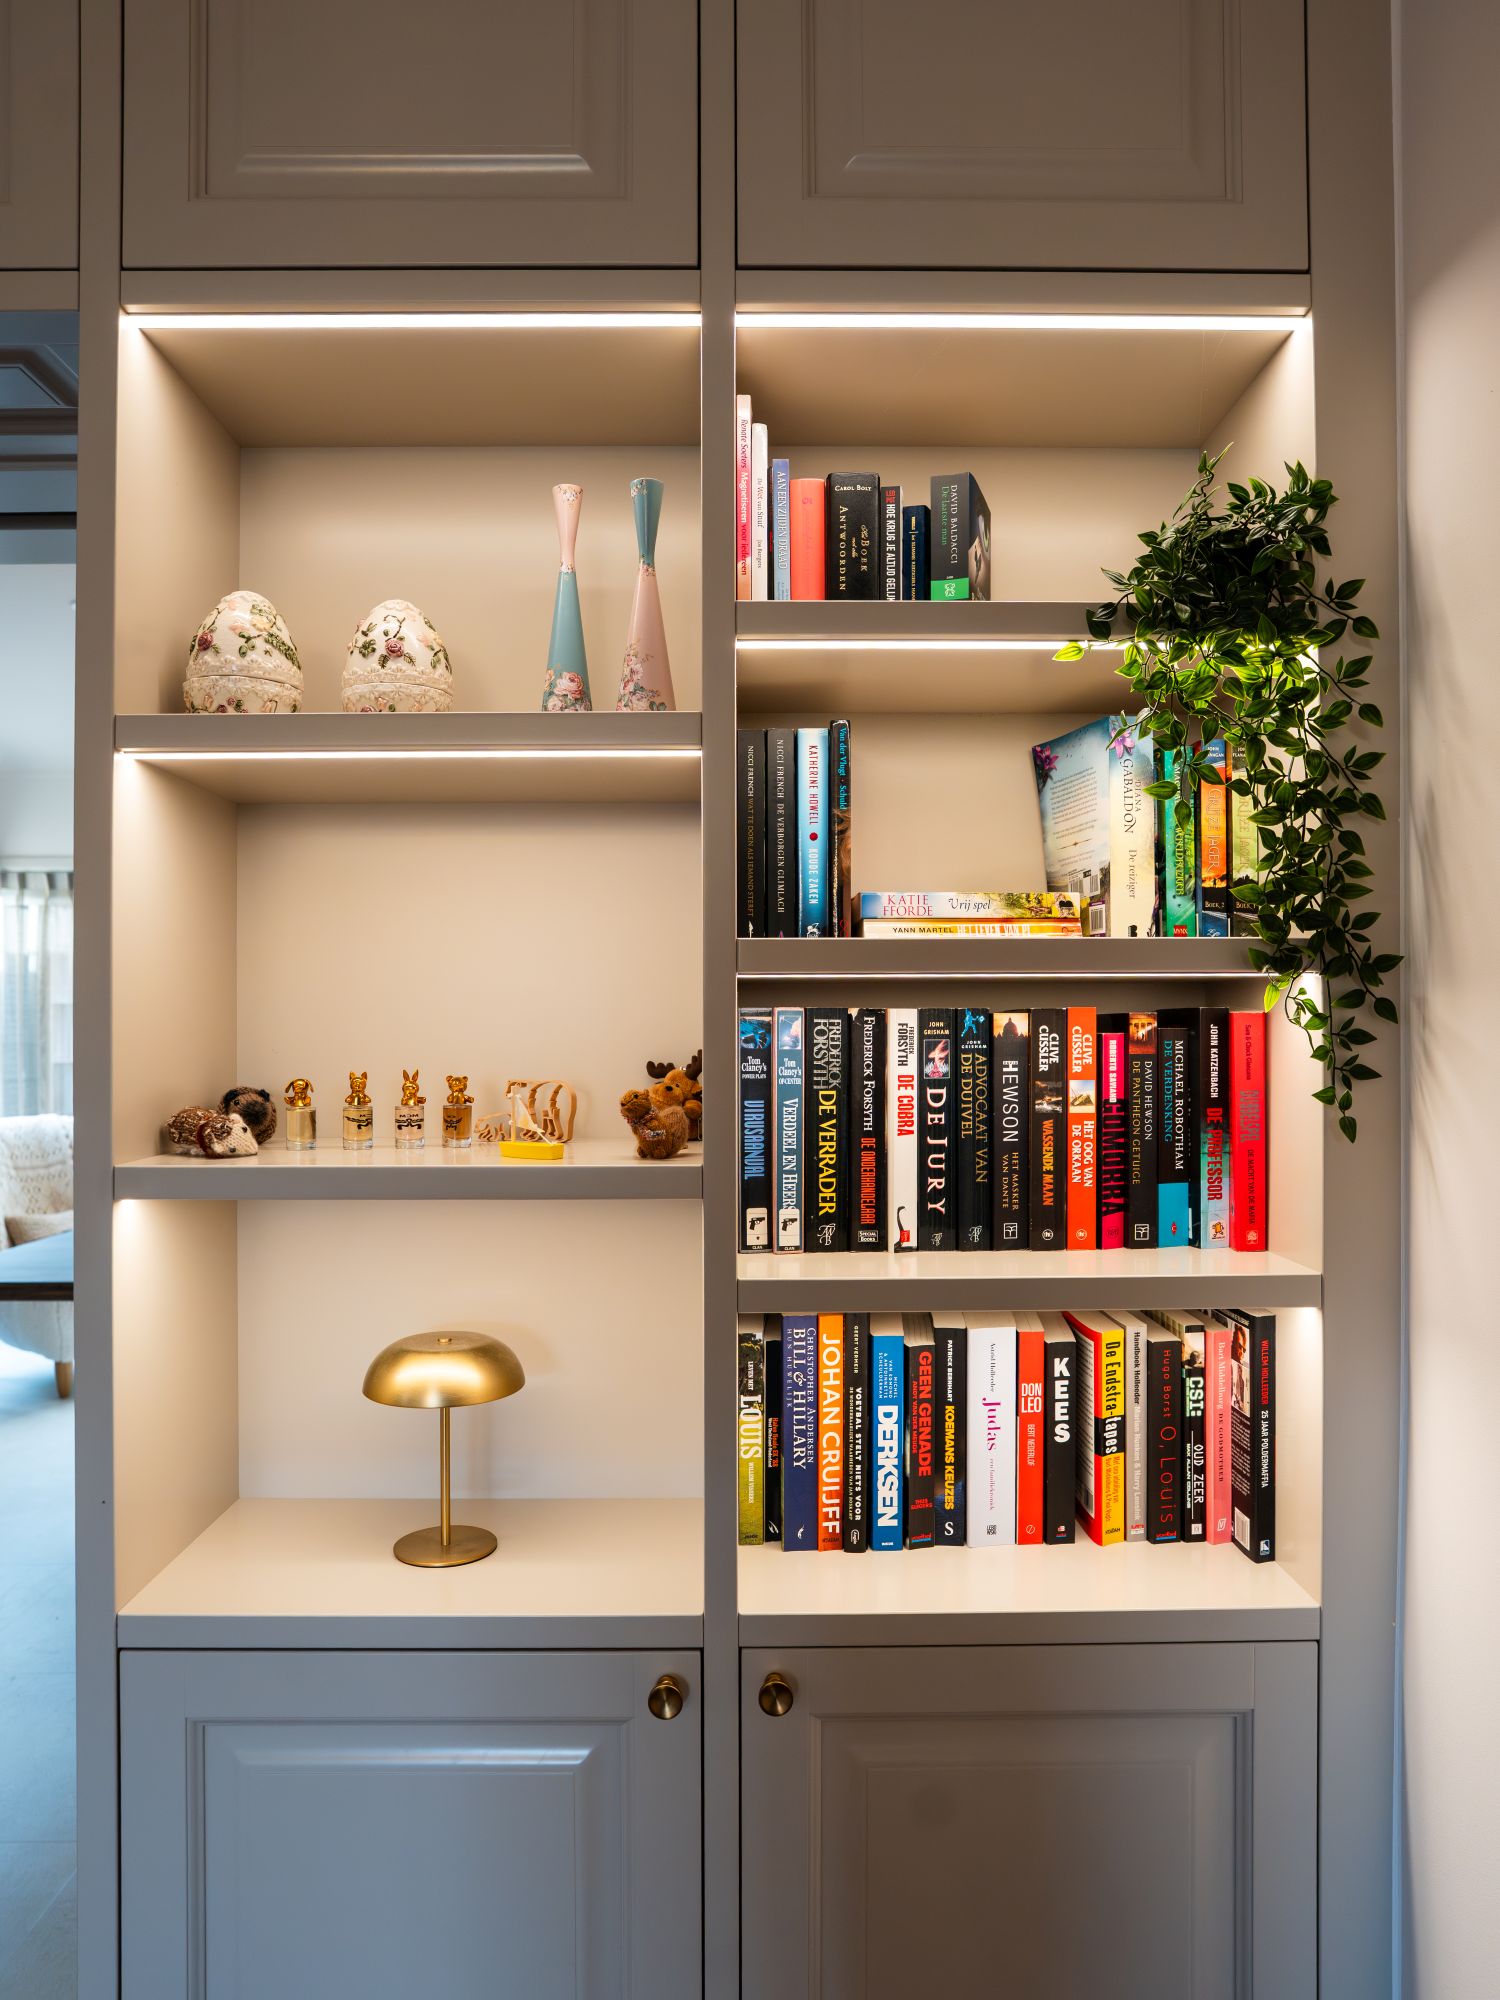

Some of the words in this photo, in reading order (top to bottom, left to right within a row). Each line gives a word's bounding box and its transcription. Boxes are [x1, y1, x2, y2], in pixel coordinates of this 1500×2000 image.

[740, 420, 748, 442] Renate
[739, 472, 748, 522] Magnetiseren
[778, 472, 786, 490] AAN
[942, 486, 949, 498] De
[778, 492, 786, 508] EEN
[942, 500, 950, 528] laatste
[776, 508, 786, 538] ZIJDEN
[740, 542, 748, 575] iedereen
[778, 539, 787, 569] DRAAD
[840, 506, 848, 590] ANTWOORDEN
[809, 745, 818, 789] KATHERINE
[838, 756, 847, 776] Vlugt
[777, 804, 784, 814] DE
[809, 794, 818, 825] HOWELL
[1120, 759, 1136, 833] GABALDON
[809, 848, 818, 874] KOUDE
[1128, 850, 1137, 862] De
[809, 878, 818, 904] ZAKEN
[1126, 863, 1137, 898] reiziger
[883, 906, 933, 916] FFORDE
[888, 895, 929, 905] KATIE
[747, 1056, 760, 1064] Tom
[813, 1018, 828, 1089] FORSYTH
[829, 1019, 841, 1088] FREDERICK
[864, 1017, 876, 1076] FREDERICK
[898, 1023, 908, 1066] FORSYTH
[1039, 1025, 1049, 1072] CUSSLER
[1050, 1033, 1059, 1064] CLIVE
[1072, 1026, 1082, 1073] CUSSLER
[1083, 1034, 1092, 1065] CLIVE
[1109, 1040, 1117, 1071] ROBERTO
[1164, 1041, 1172, 1057] DE
[741, 1062, 767, 1073] Clancy's
[779, 1067, 801, 1077] Clancy's
[784, 1058, 796, 1067] Tom
[961, 1053, 972, 1073] DE
[1132, 1062, 1140, 1073] DE
[1175, 1040, 1183, 1095] MICHAEL
[898, 1075, 914, 1090] DE
[975, 1053, 987, 1142] ADVOCAAT
[1109, 1073, 1117, 1102] SAVIANO
[819, 1090, 836, 1115] DE
[864, 1080, 875, 1131] FORSYTH
[897, 1095, 914, 1136] COBRA
[927, 1087, 946, 1125] DE
[961, 1079, 972, 1138] DUIVEL
[1003, 1061, 1019, 1141] HEWSON
[1132, 1078, 1140, 1134] PANTHEON
[1164, 1059, 1172, 1142] VERDENKING
[1207, 1108, 1222, 1124] DE
[744, 1100, 764, 1180] VIRUSAANVAL
[783, 1098, 798, 1152] VERDEEL
[1072, 1125, 1081, 1137] DE
[1084, 1120, 1094, 1139] HET
[1175, 1100, 1183, 1170] ROBOTHAM
[861, 1138, 876, 1148] DE
[1042, 1119, 1054, 1171] WASSENDE
[1084, 1142, 1093, 1164] OOG
[1101, 1100, 1127, 1216] GOMORRA
[783, 1155, 796, 1171] EN
[819, 1119, 836, 1216] VERRADER
[927, 1136, 948, 1215] JURY
[976, 1149, 988, 1183] VAN
[1072, 1140, 1081, 1183] ORKAAN
[1084, 1166, 1093, 1187] VAN
[1132, 1140, 1140, 1184] GETUIGE
[1207, 1129, 1223, 1200] PROFESSOR
[861, 1151, 876, 1224] ONDERHANDELAAR
[1043, 1174, 1054, 1206] MAAN
[793, 1328, 806, 1369] BILL
[807, 1328, 816, 1402] CHRISTOPHER
[1105, 1341, 1120, 1357] De
[1162, 1350, 1171, 1379] Hugo
[1261, 1339, 1269, 1366] WILLEM
[793, 1372, 806, 1386] &
[822, 1333, 840, 1425] JOHAN
[919, 1351, 932, 1399] GEEN
[1021, 1383, 1042, 1396] DON
[1216, 1362, 1226, 1409] Middelburg
[1261, 1367, 1269, 1405] HOLLEEDER
[1021, 1397, 1042, 1413] LEO
[1054, 1358, 1071, 1443] KEES
[1163, 1385, 1171, 1418] Borst
[1190, 1376, 1204, 1416] CSI:
[740, 1394, 762, 1459] LOUIS
[793, 1391, 806, 1469] HILLARY
[982, 1397, 1001, 1451] Judas
[1261, 1410, 1268, 1418] 25
[807, 1407, 816, 1463] ANDERSEN
[918, 1403, 932, 1477] GENADE
[945, 1405, 955, 1464] KOEMANS
[1159, 1427, 1176, 1448] O,
[877, 1405, 898, 1526] DERKSEN
[1027, 1440, 1035, 1466] NEDERLOF
[1194, 1444, 1203, 1466] OUD
[1261, 1438, 1269, 1488] POLDERMAFFIA
[822, 1431, 840, 1534] CRUIJFF
[944, 1465, 954, 1511] KEUZES
[1160, 1457, 1177, 1522] Louis
[1194, 1474, 1204, 1503] ZEER
